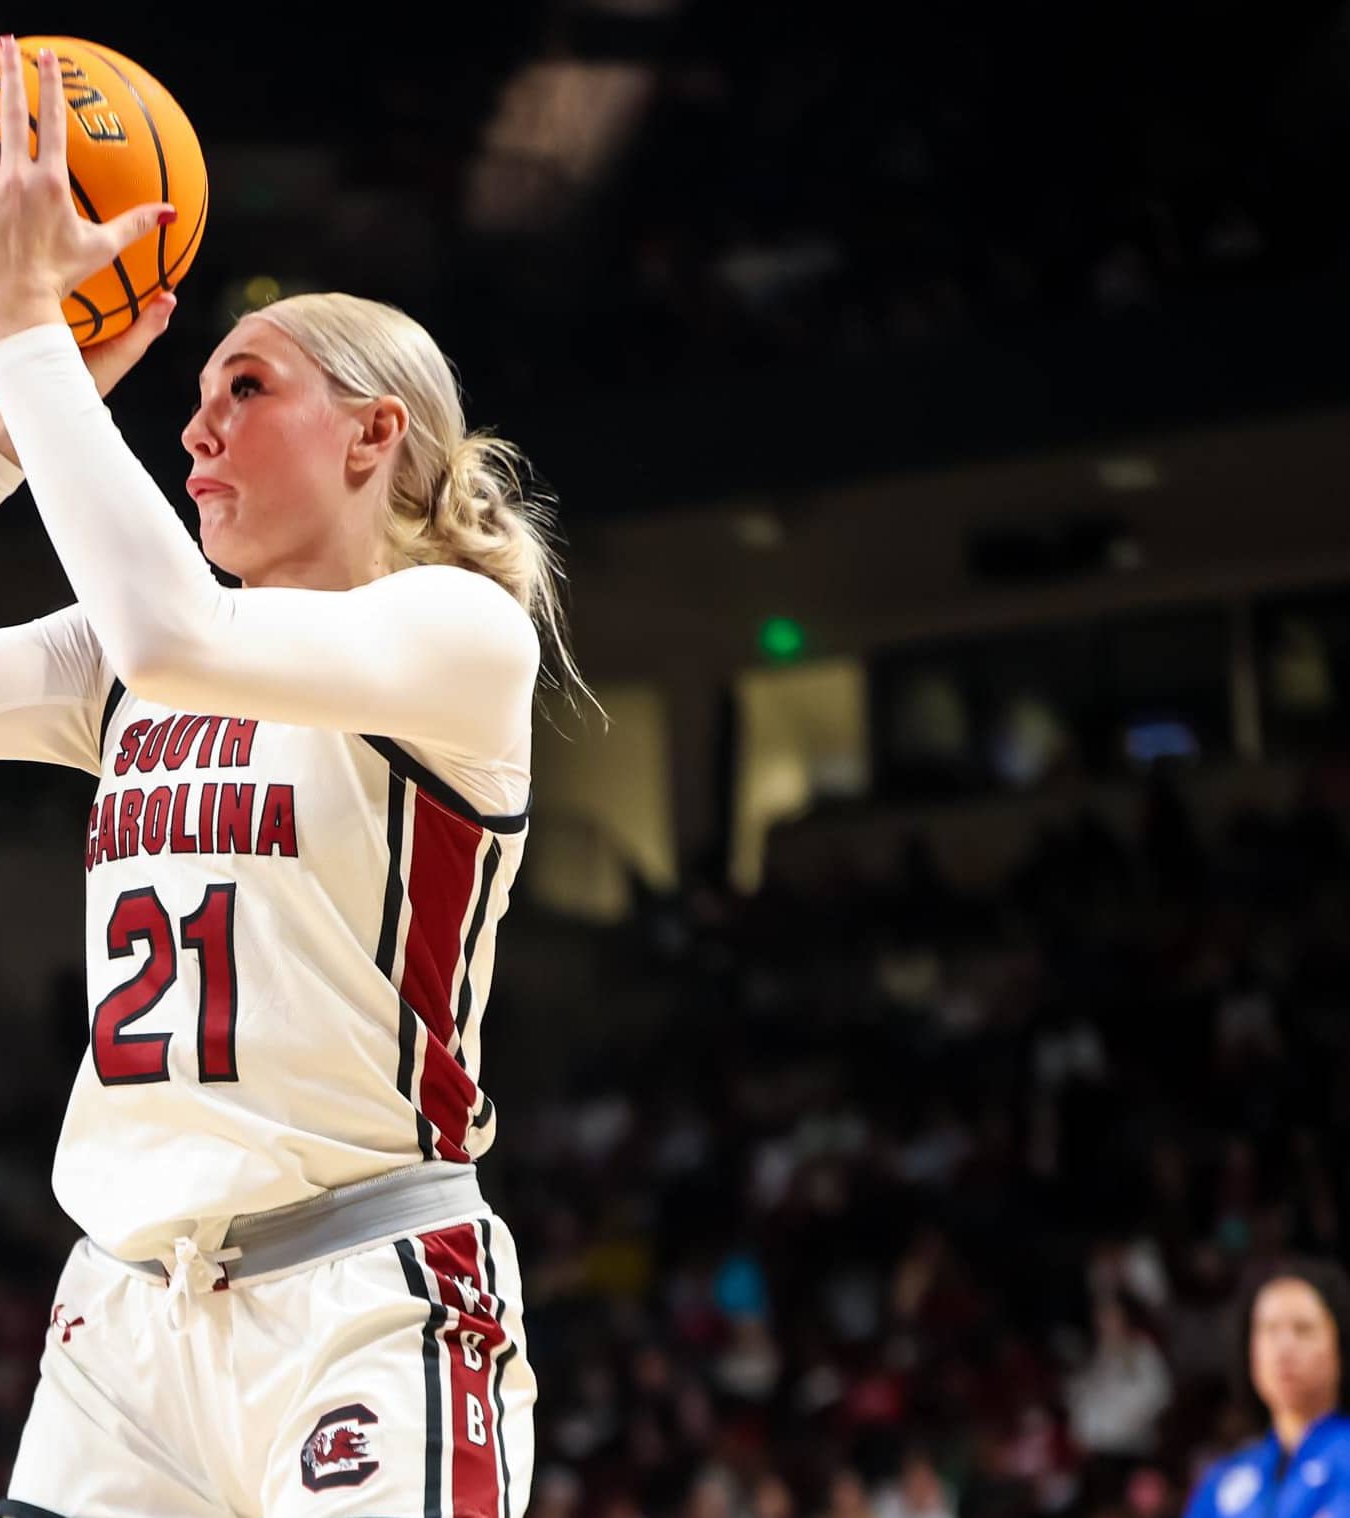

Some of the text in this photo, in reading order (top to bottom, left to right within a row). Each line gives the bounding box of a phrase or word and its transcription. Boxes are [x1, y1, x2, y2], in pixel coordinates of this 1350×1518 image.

[114, 713, 259, 777] SOUTH
[85, 783, 299, 873] CAROLINA
[91, 882, 239, 1086] 21
